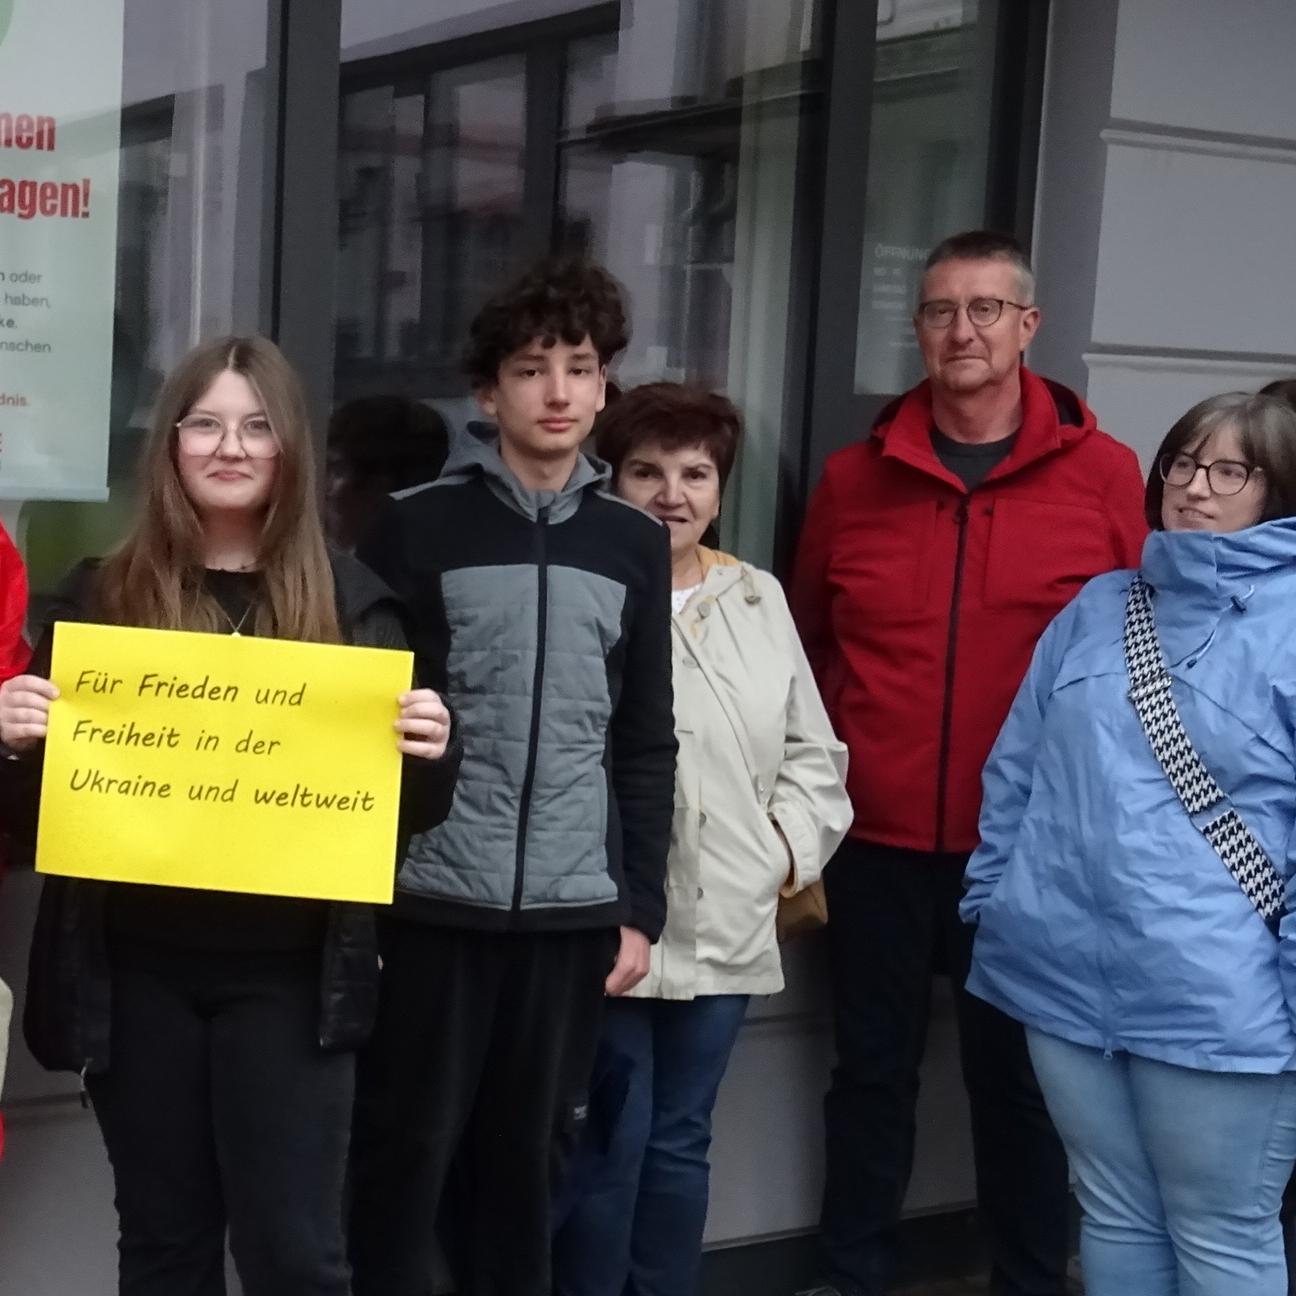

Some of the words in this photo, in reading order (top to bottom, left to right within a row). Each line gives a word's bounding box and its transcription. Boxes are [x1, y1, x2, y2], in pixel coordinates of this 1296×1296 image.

[8, 270, 42, 284] oder
[5, 292, 50, 308] haben,
[75, 670, 123, 695] Für
[138, 673, 239, 702] Frieden
[255, 683, 307, 706] und
[72, 720, 180, 748] Freiheit
[195, 730, 219, 752] in
[235, 730, 281, 755] der
[69, 768, 172, 799] Ukraine
[188, 779, 239, 803] und
[254, 784, 375, 812] weltweit
